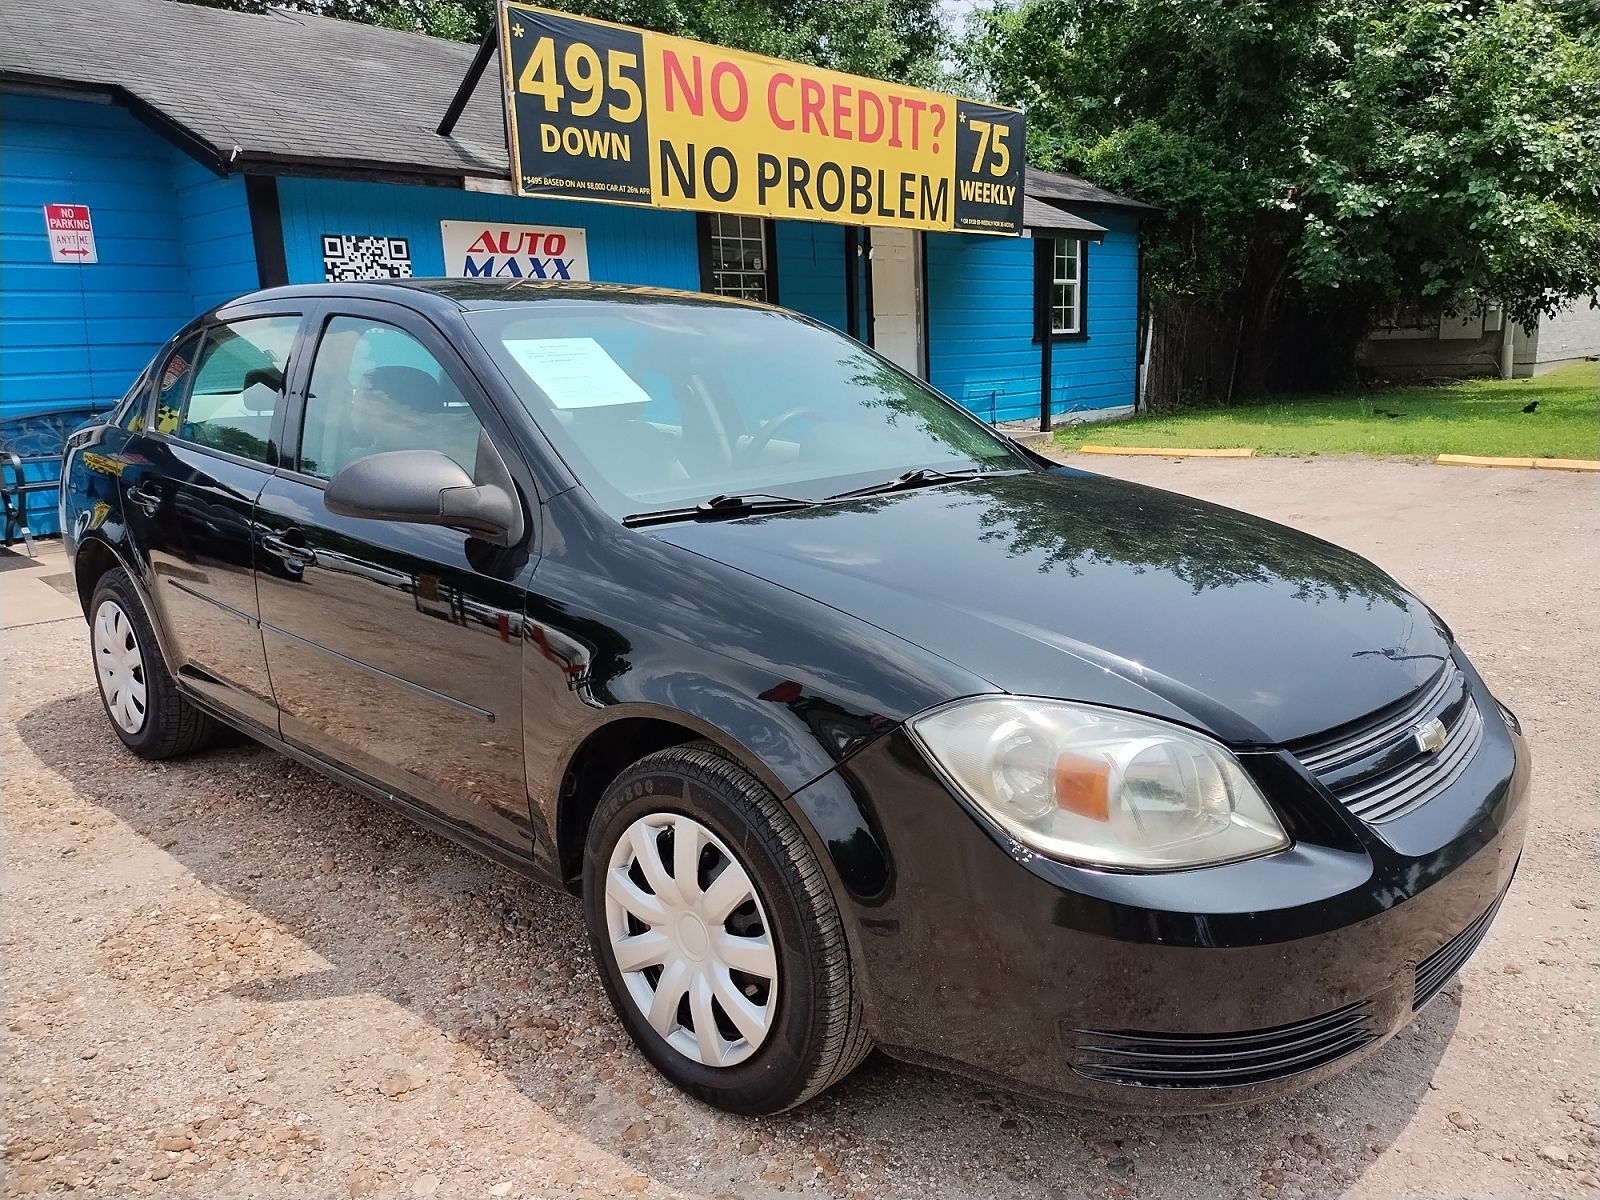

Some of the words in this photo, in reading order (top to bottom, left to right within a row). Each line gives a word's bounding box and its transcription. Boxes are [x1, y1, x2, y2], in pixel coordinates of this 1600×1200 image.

[662, 49, 748, 122] NO
[767, 72, 946, 154] CREDIT?
[540, 123, 631, 162] DOWN
[543, 177, 564, 187] BASED
[565, 179, 575, 188] ON
[576, 180, 586, 189] AN
[606, 183, 619, 192] CAR
[619, 185, 626, 193] AT
[659, 139, 738, 202] NO
[757, 152, 949, 222] PROBLEM
[960, 180, 1016, 206] WEEKLY
[50, 219, 90, 230] PARKING
[61, 208, 74, 218] NO
[57, 235, 89, 245] ANYTME
[466, 230, 566, 256] AUTO
[463, 255, 575, 280] MAXX
